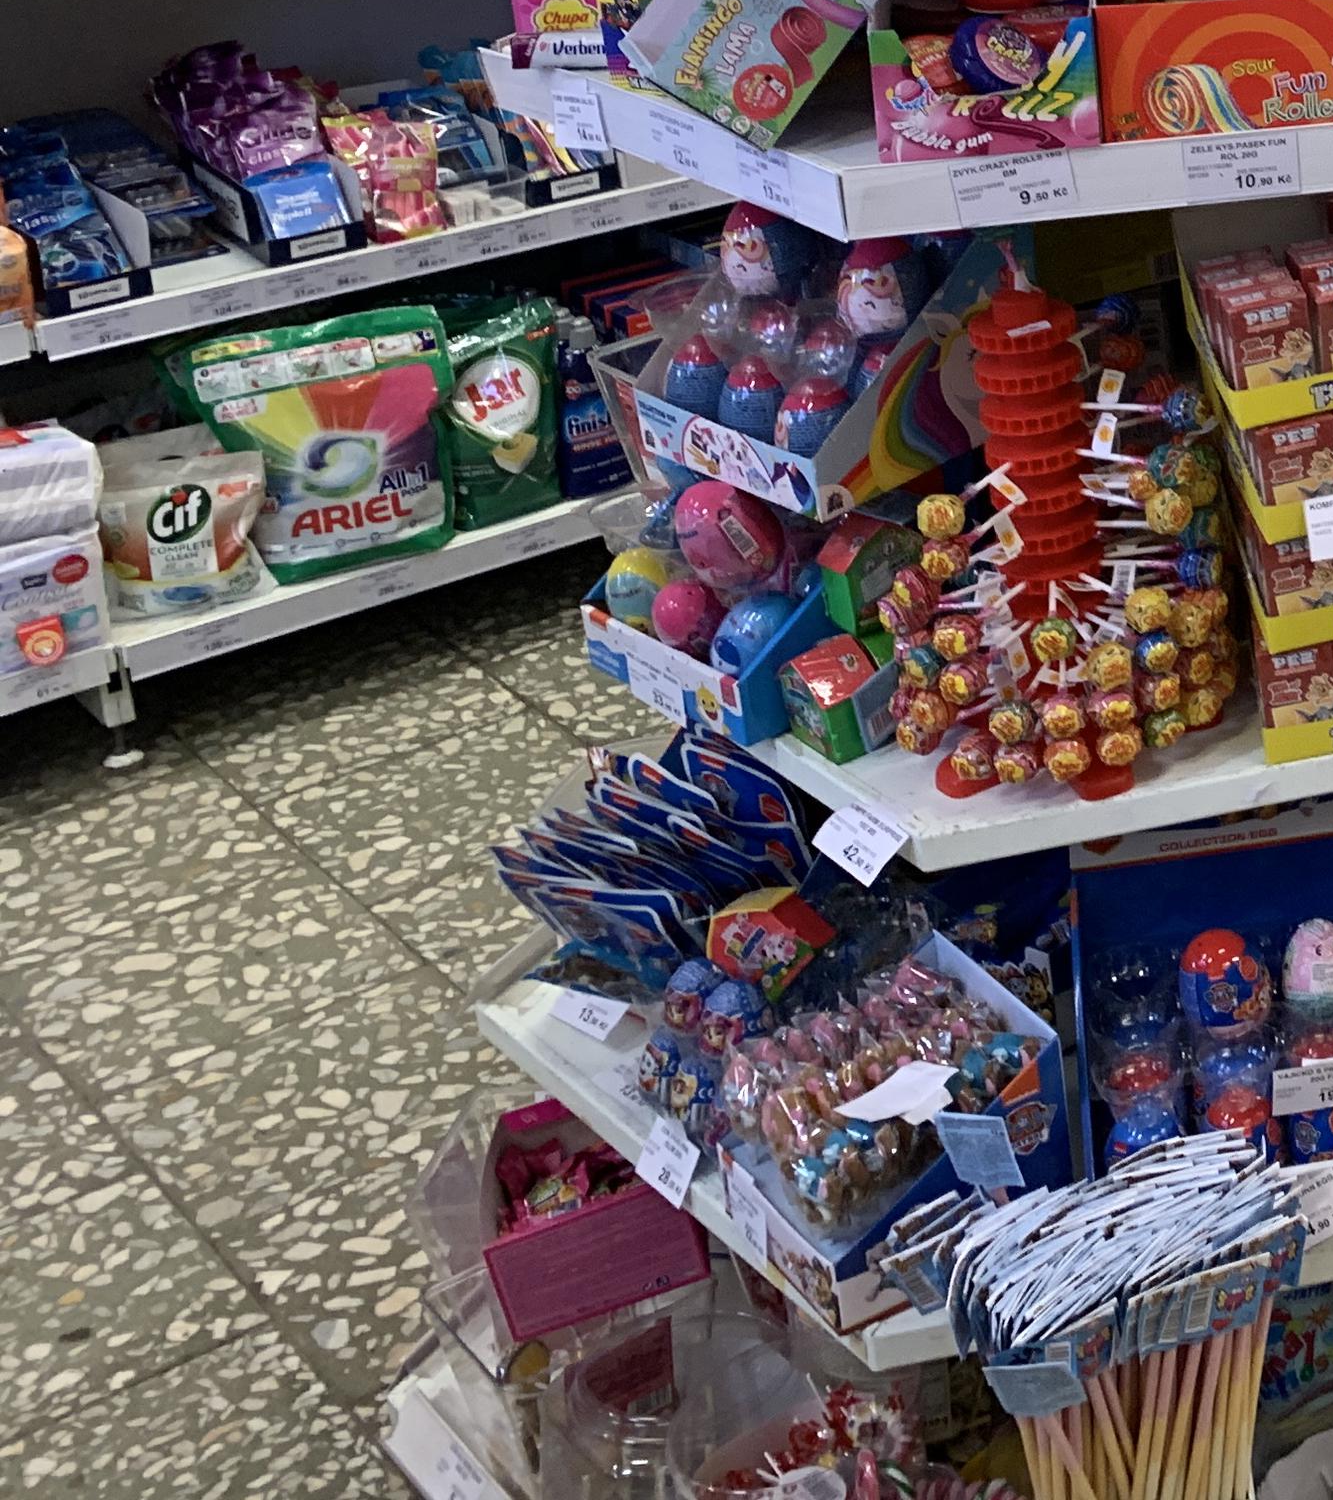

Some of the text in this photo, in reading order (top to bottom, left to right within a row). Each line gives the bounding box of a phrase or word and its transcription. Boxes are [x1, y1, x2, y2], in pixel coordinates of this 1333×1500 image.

[543, 11, 587, 27] Chupa
[553, 41, 606, 57] Verben
[716, 21, 757, 78] LAMA
[1231, 57, 1276, 78] Sour
[1273, 70, 1327, 99] Fun
[956, 132, 993, 153] gum
[1235, 174, 1273, 189] 10,90
[1244, 303, 1293, 326] PEZ
[1272, 423, 1317, 446] PEZ
[153, 491, 202, 540] Cif
[292, 495, 412, 539] ARIEL
